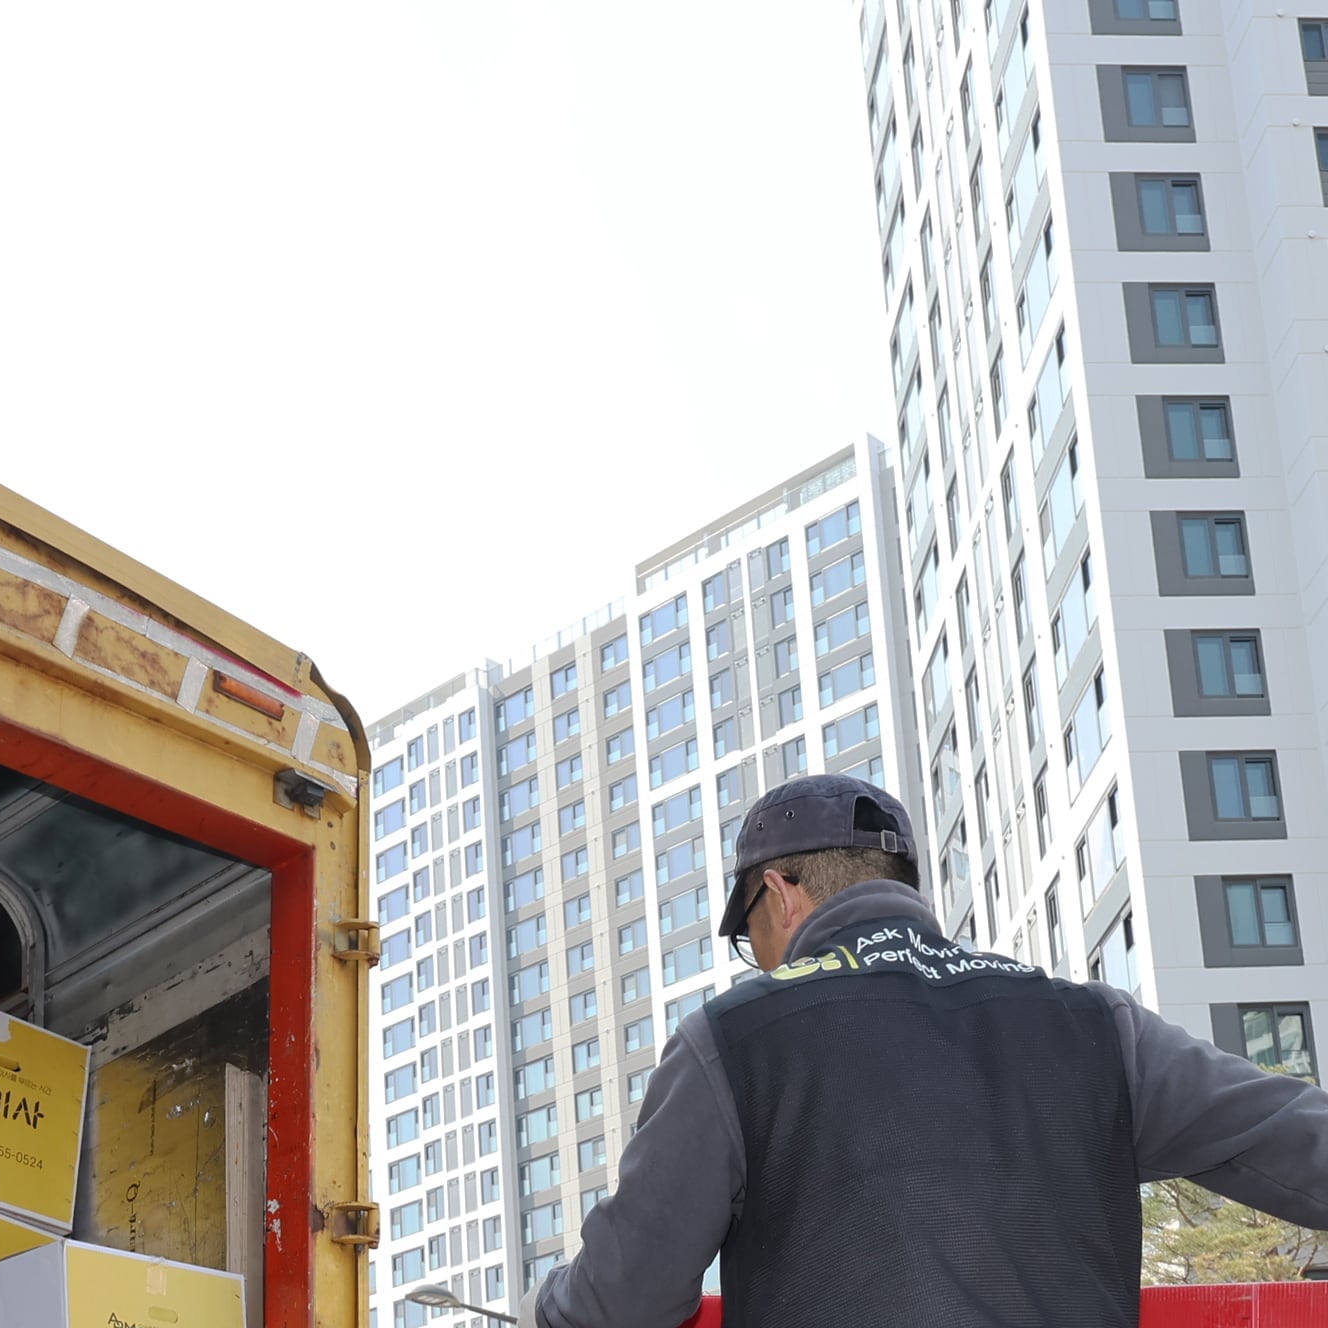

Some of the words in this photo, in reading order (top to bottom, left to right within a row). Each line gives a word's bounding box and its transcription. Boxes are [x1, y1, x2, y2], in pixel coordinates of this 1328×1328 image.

[856, 928, 903, 953] Ask
[863, 948, 942, 979] Perfect
[945, 959, 1036, 975] Moving
